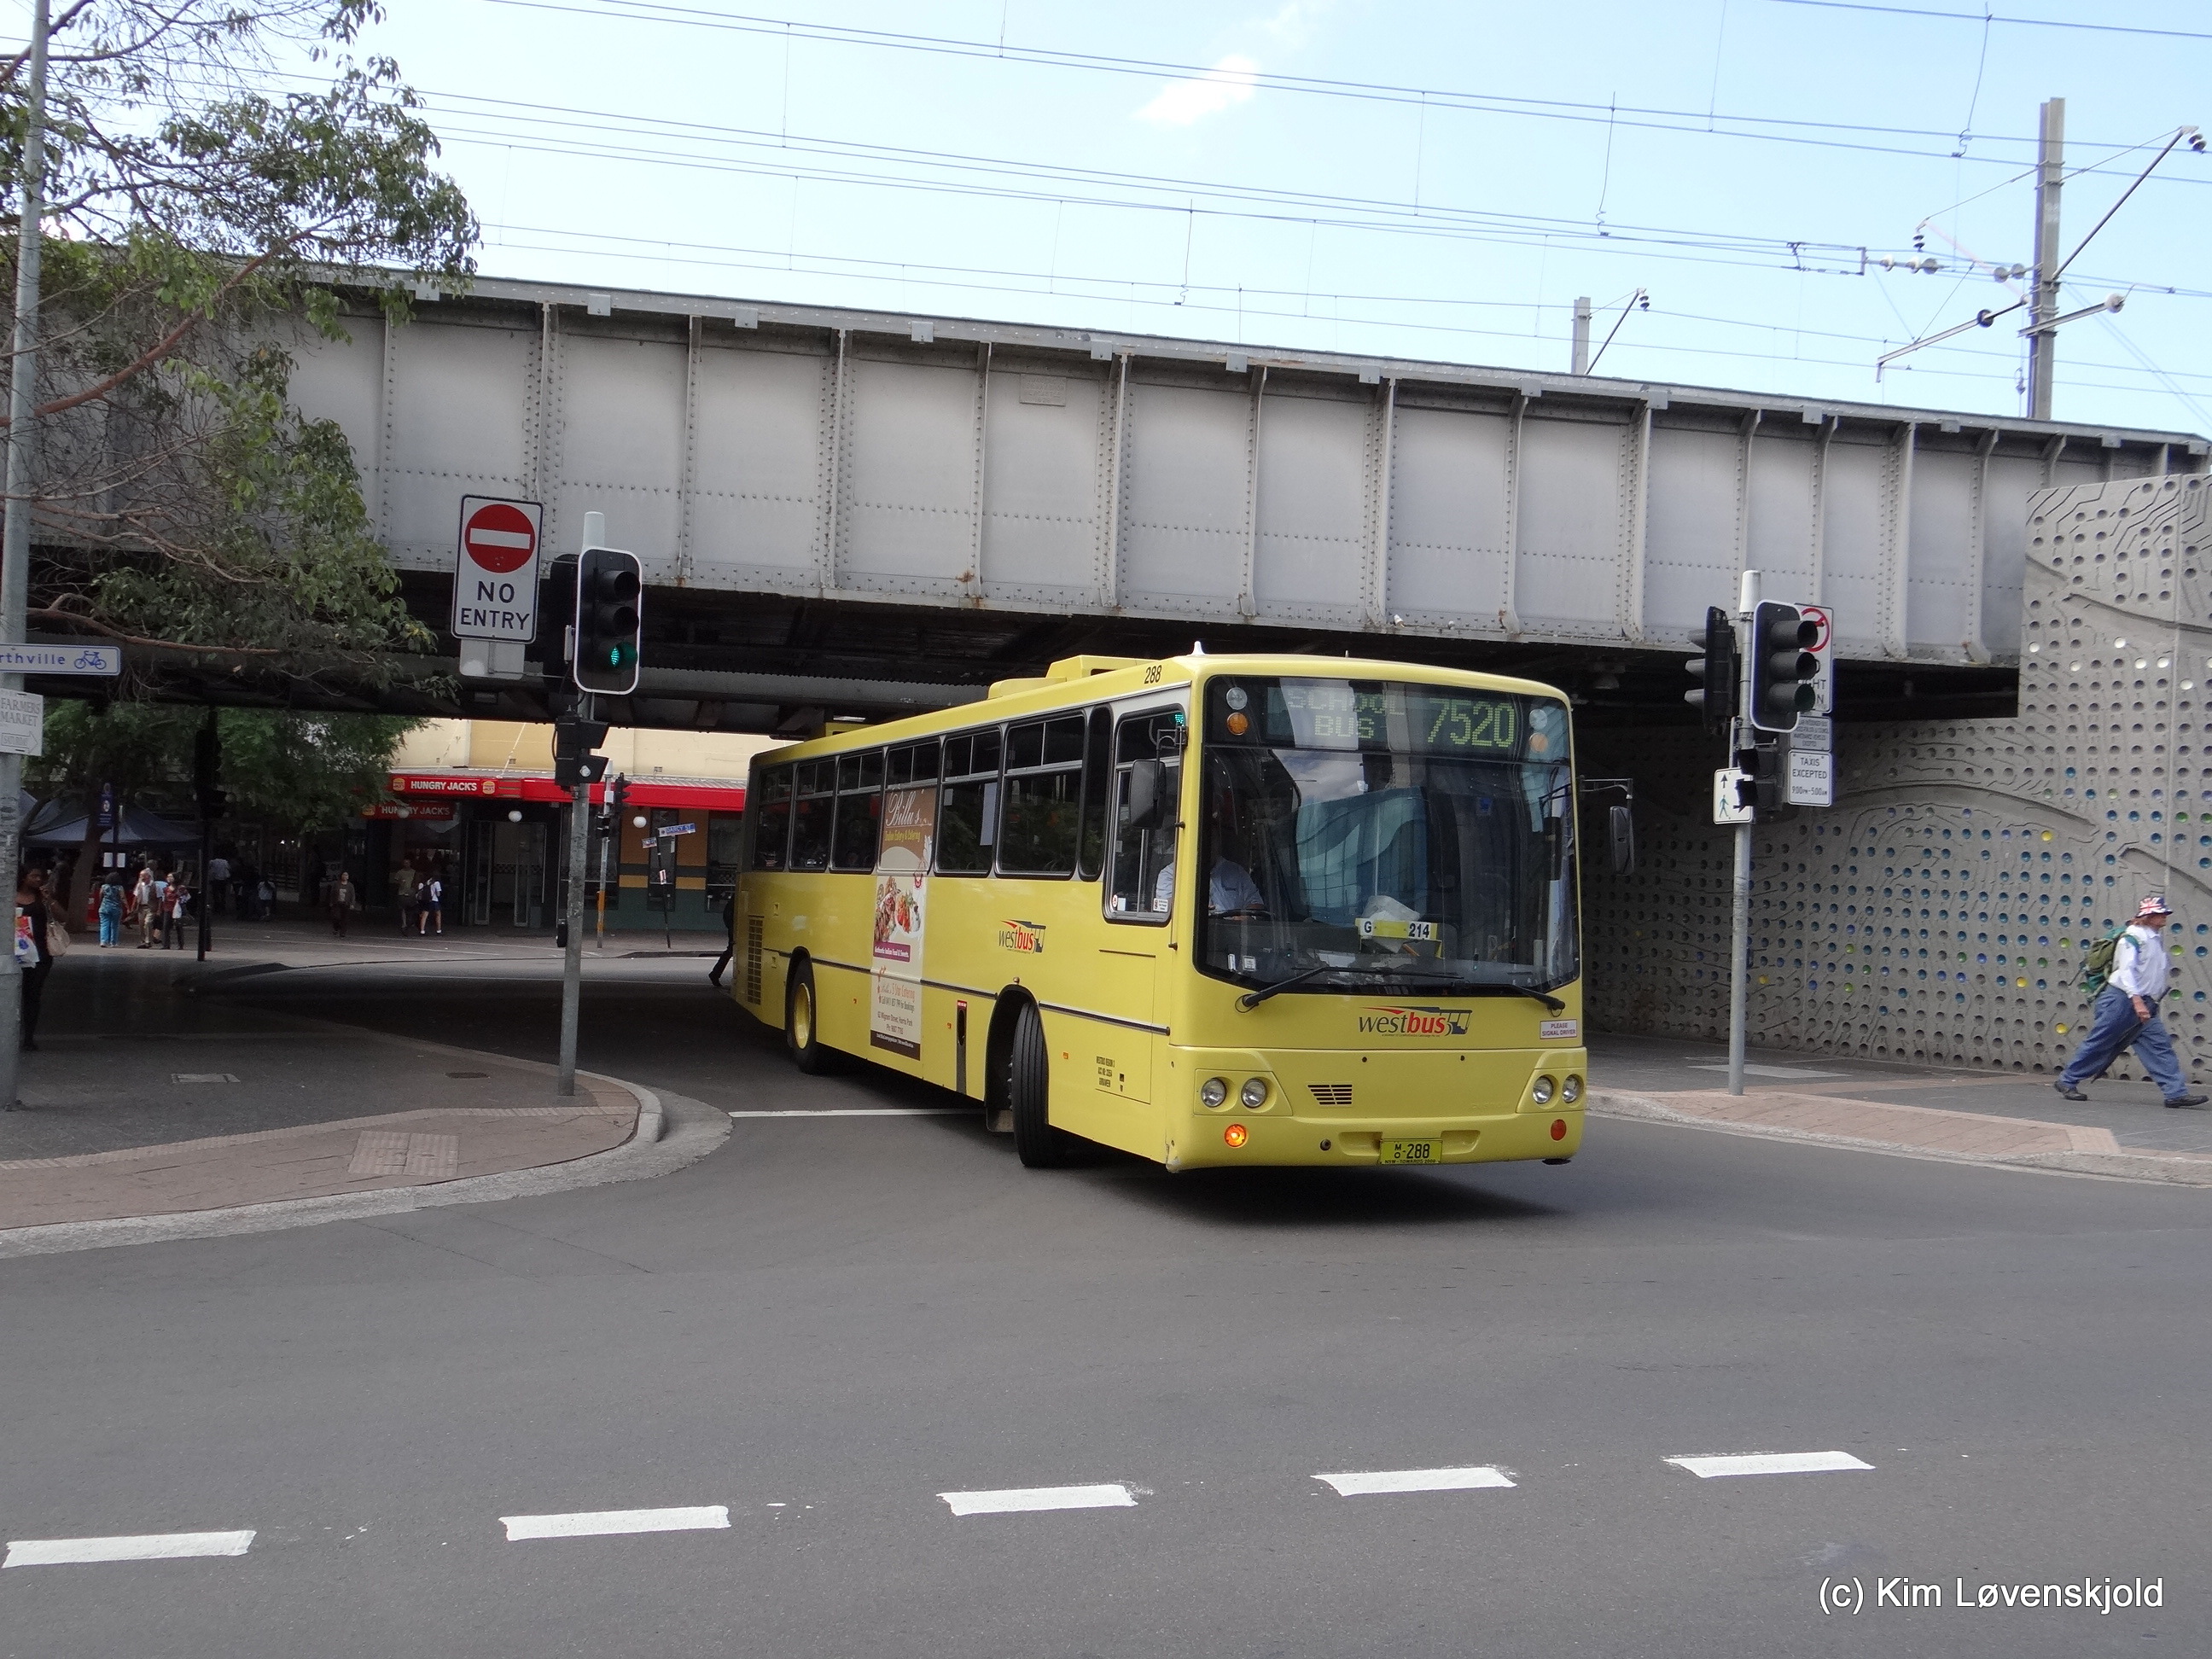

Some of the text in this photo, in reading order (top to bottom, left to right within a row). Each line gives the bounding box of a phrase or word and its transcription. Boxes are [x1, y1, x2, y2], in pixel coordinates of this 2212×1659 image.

[477, 580, 515, 604] NO
[461, 608, 531, 631] ENTRY
[1144, 665, 1162, 684] 288
[1, 697, 41, 715] FARMERS
[0, 710, 38, 727] MARKET
[1315, 714, 1375, 740] BUS
[1428, 697, 1515, 748] 7520
[1801, 757, 1820, 767] TAXIS
[1792, 769, 1827, 779] EXCEPTED
[410, 780, 446, 791] HUNGRY
[446, 782, 477, 792] JACK'S
[381, 806, 418, 815] HUNRY
[419, 806, 450, 816] JACK'S
[998, 927, 1034, 951] westbus
[1364, 921, 1429, 939] G 214
[1359, 1011, 1446, 1035] westbus
